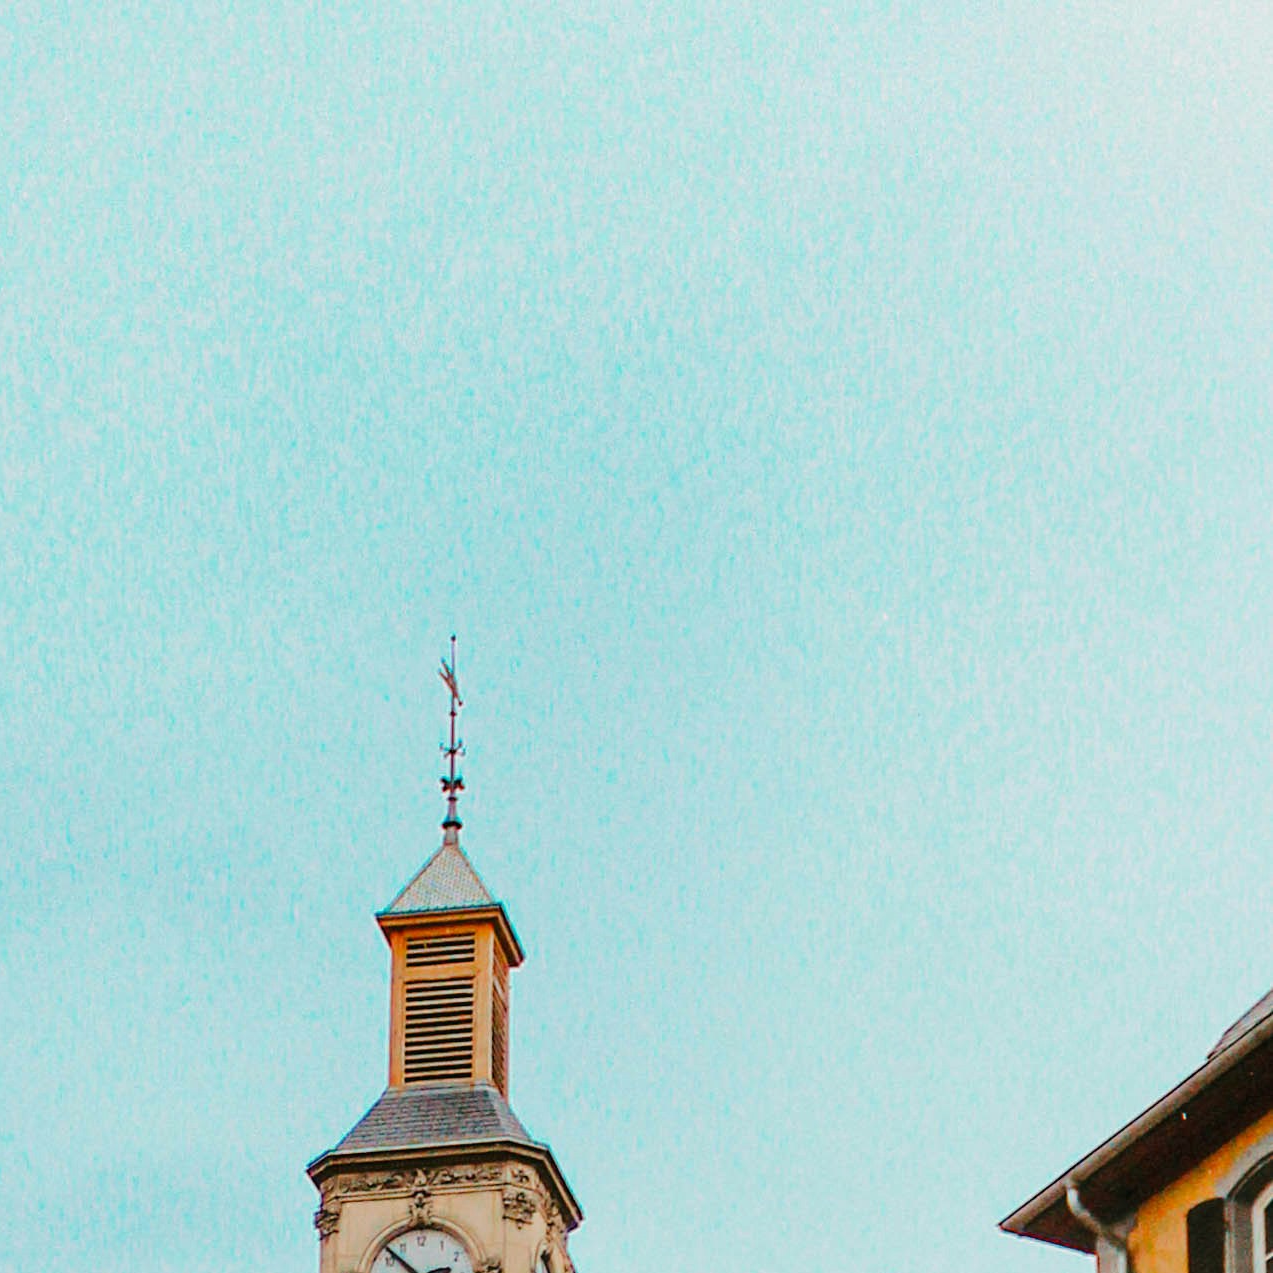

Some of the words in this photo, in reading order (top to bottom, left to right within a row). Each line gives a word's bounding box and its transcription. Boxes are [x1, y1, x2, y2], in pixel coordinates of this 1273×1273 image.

[416, 1236, 426, 1247] 12
[400, 1243, 407, 1252] 11
[385, 1256, 395, 1267] 10
[454, 1251, 460, 1262] 2
